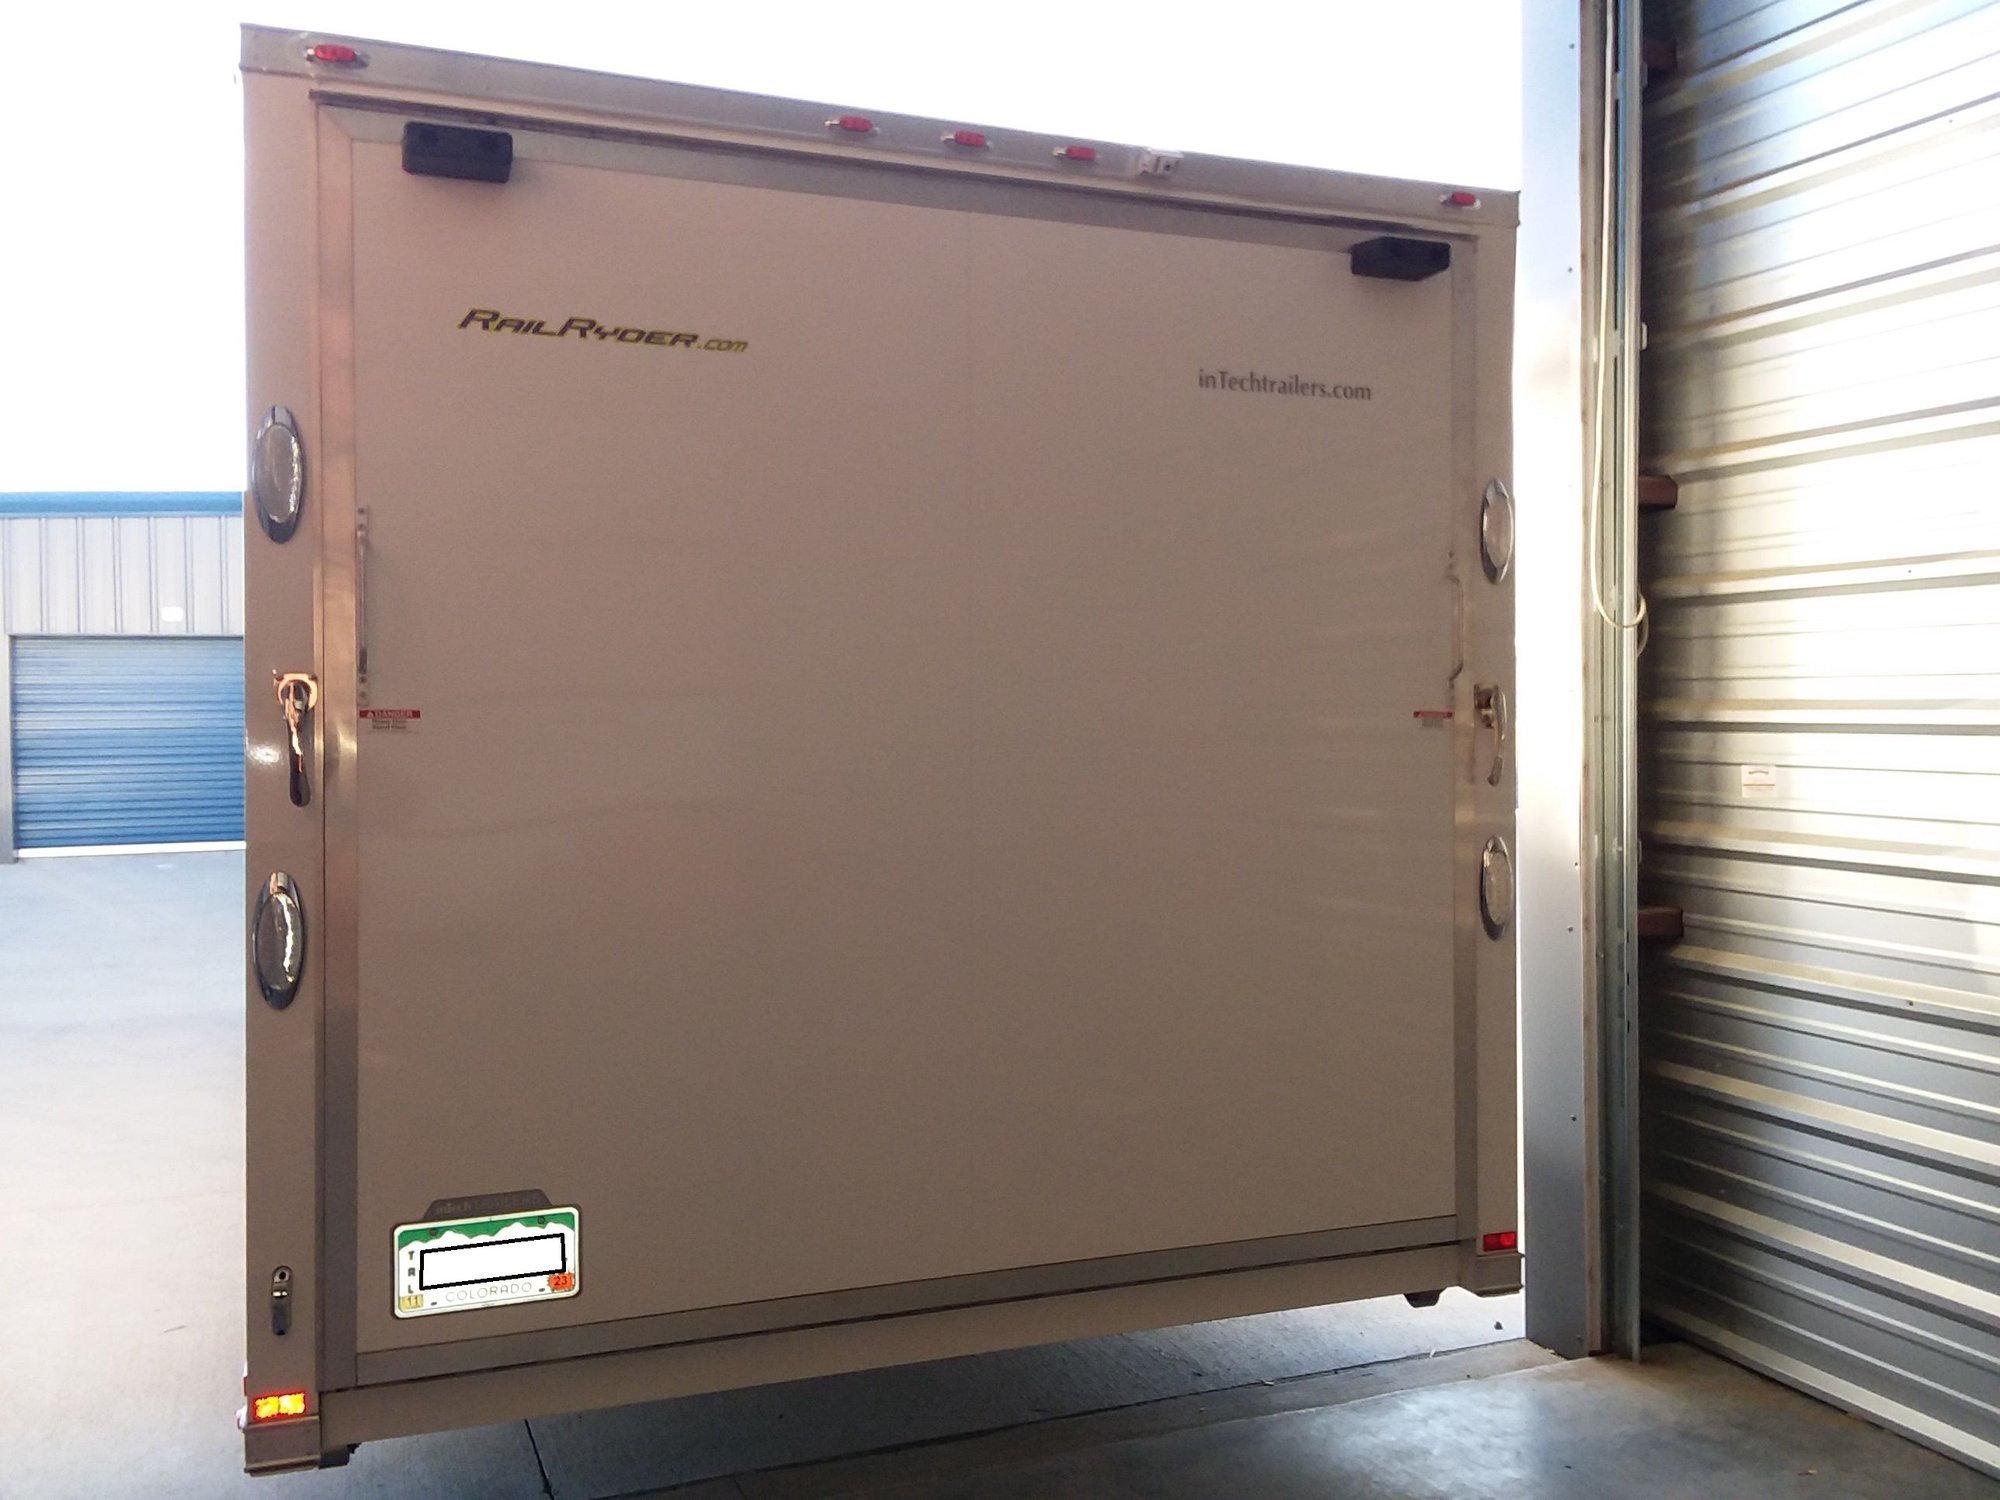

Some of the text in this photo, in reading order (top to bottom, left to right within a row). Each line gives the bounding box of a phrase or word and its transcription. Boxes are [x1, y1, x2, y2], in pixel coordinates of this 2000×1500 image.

[1199, 369, 1372, 400] inTechtrailers.com
[554, 1275, 568, 1287] 23
[446, 1282, 532, 1302] COLORADO
[407, 1296, 419, 1307] 11
